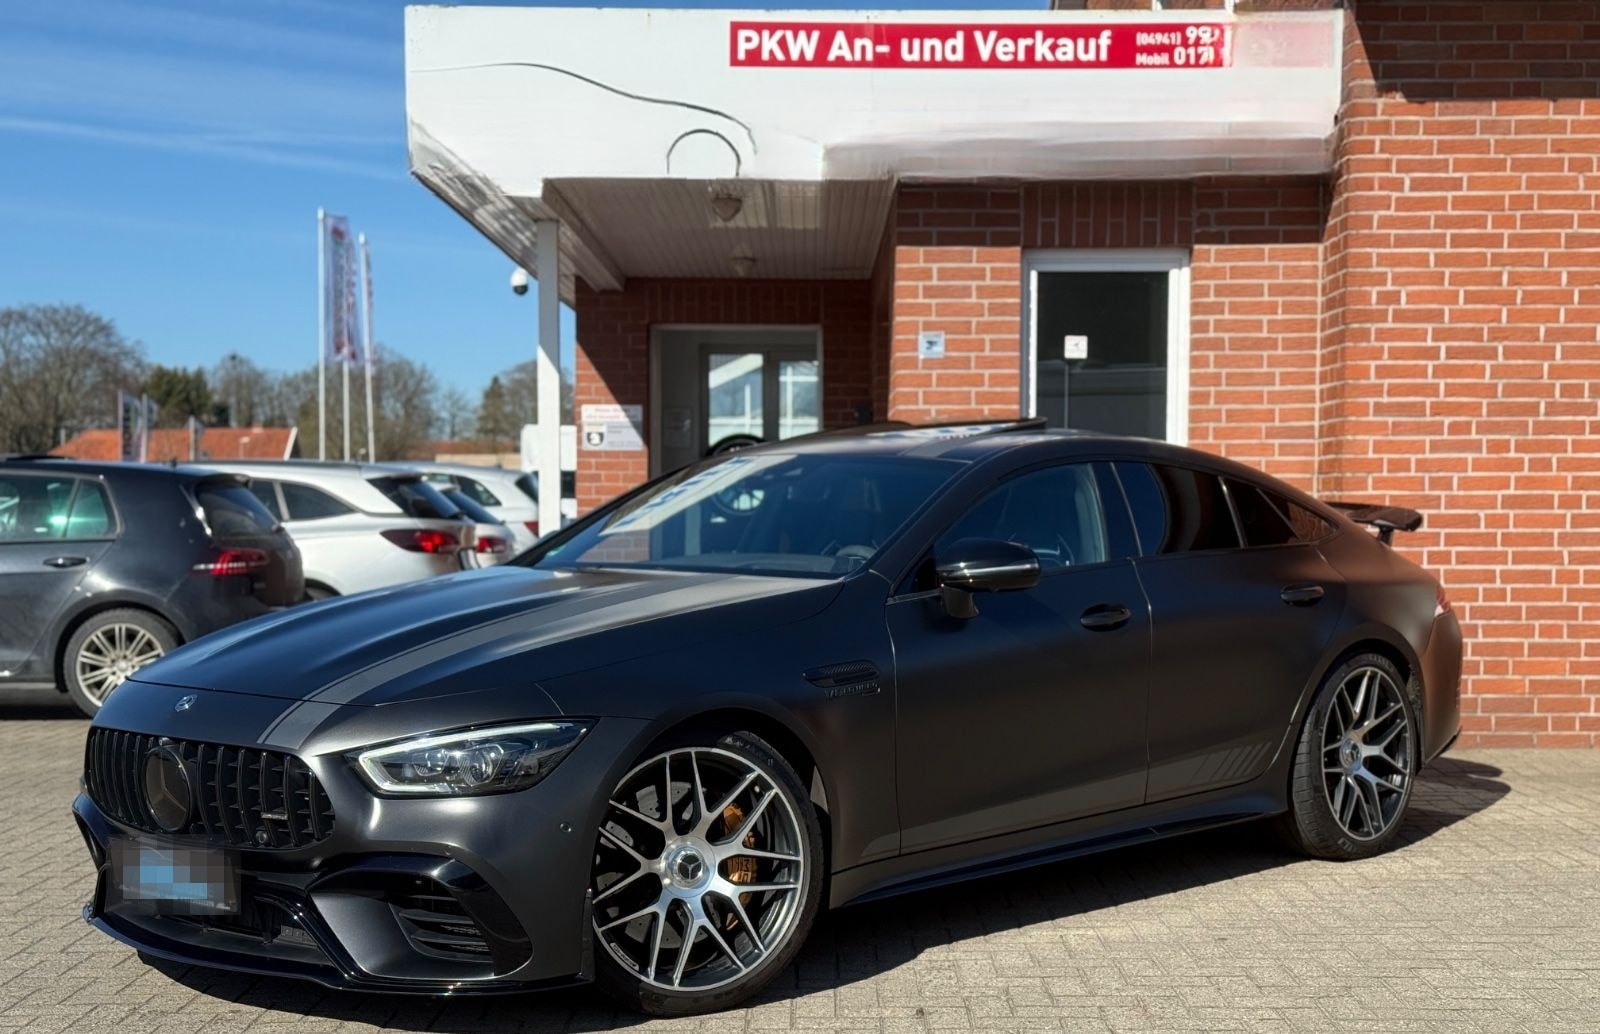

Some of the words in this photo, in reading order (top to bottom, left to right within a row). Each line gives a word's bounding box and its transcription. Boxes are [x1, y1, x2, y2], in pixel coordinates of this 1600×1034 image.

[737, 29, 820, 61] PKW
[826, 30, 890, 61] An-
[900, 30, 964, 62] und
[973, 30, 1111, 62] Verkauf
[1135, 53, 1169, 65] Mobil
